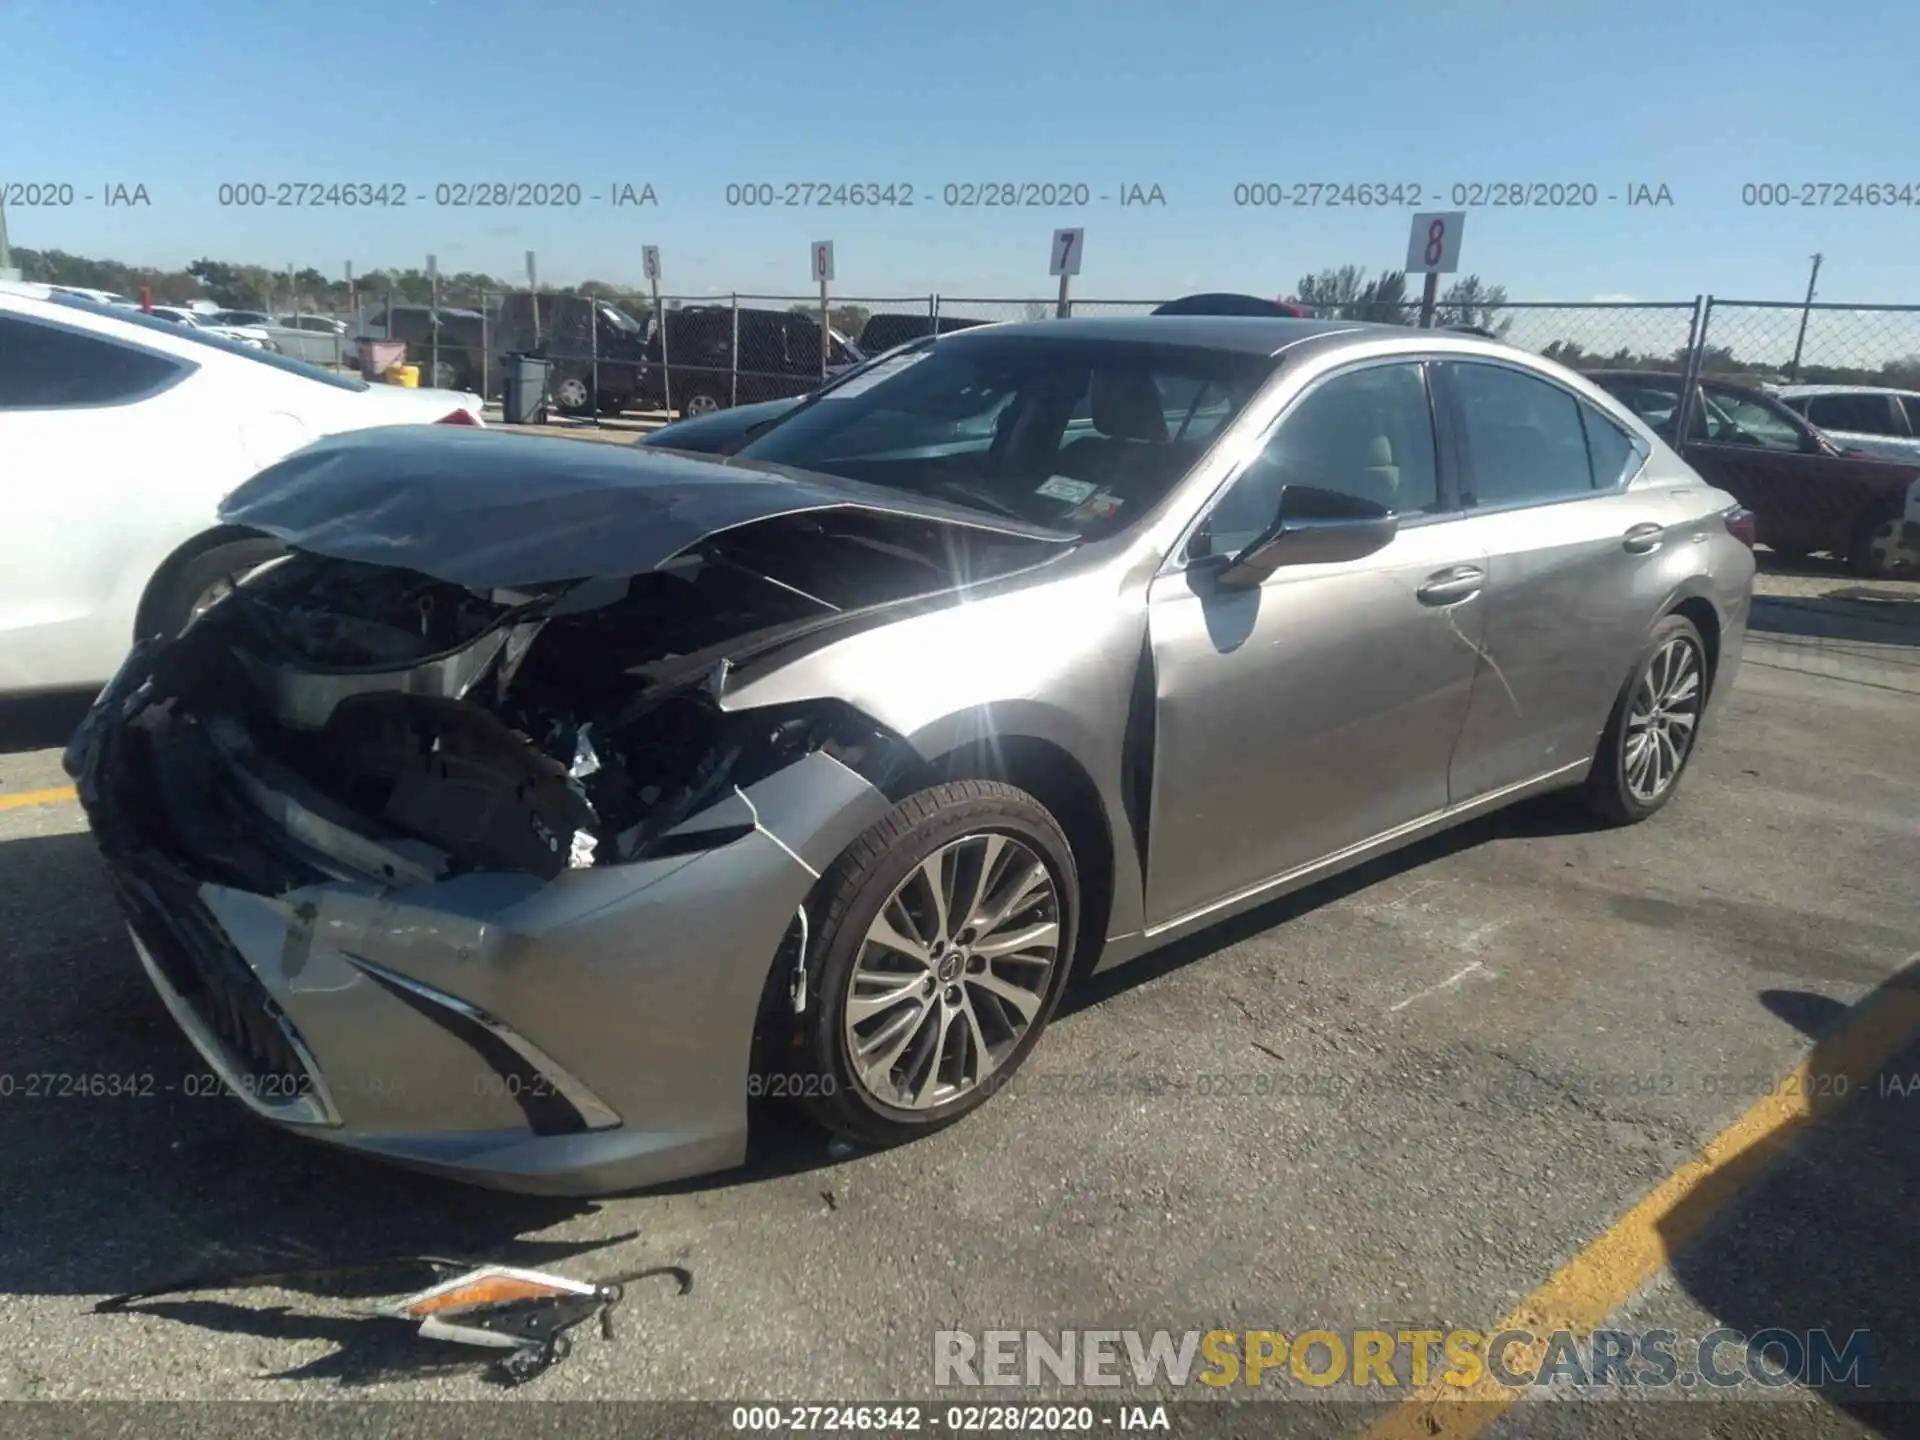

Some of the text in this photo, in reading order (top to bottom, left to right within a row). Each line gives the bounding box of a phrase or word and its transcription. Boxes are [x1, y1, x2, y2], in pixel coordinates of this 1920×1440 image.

[1060, 232, 1075, 269] 7
[1424, 219, 1445, 267] 8
[647, 249, 656, 276] 5
[817, 245, 827, 276] 6
